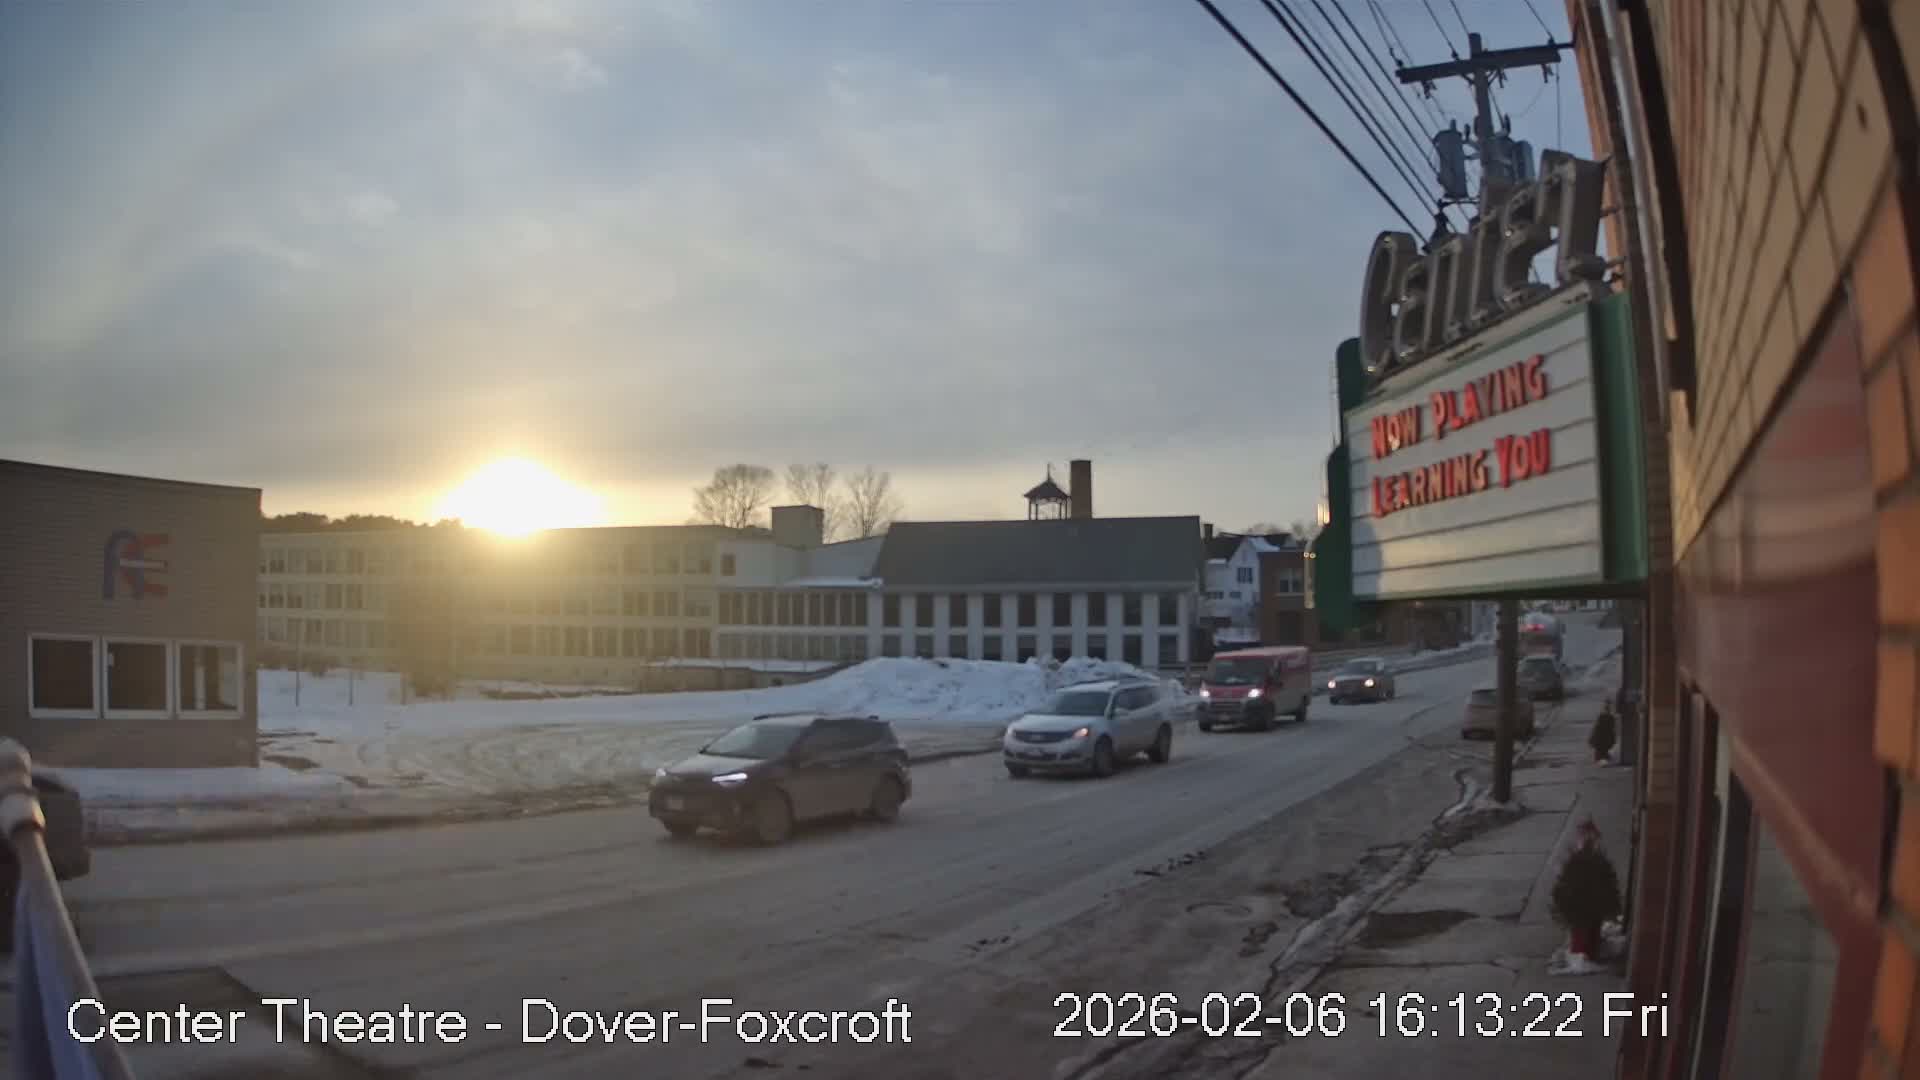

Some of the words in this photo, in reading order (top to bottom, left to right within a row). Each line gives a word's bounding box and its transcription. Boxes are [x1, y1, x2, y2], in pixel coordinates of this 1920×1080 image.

[1371, 405, 1421, 460] NOW
[1430, 353, 1548, 440] PLAYING
[1371, 449, 1489, 518] LEARNING
[1495, 427, 1551, 488] YOU
